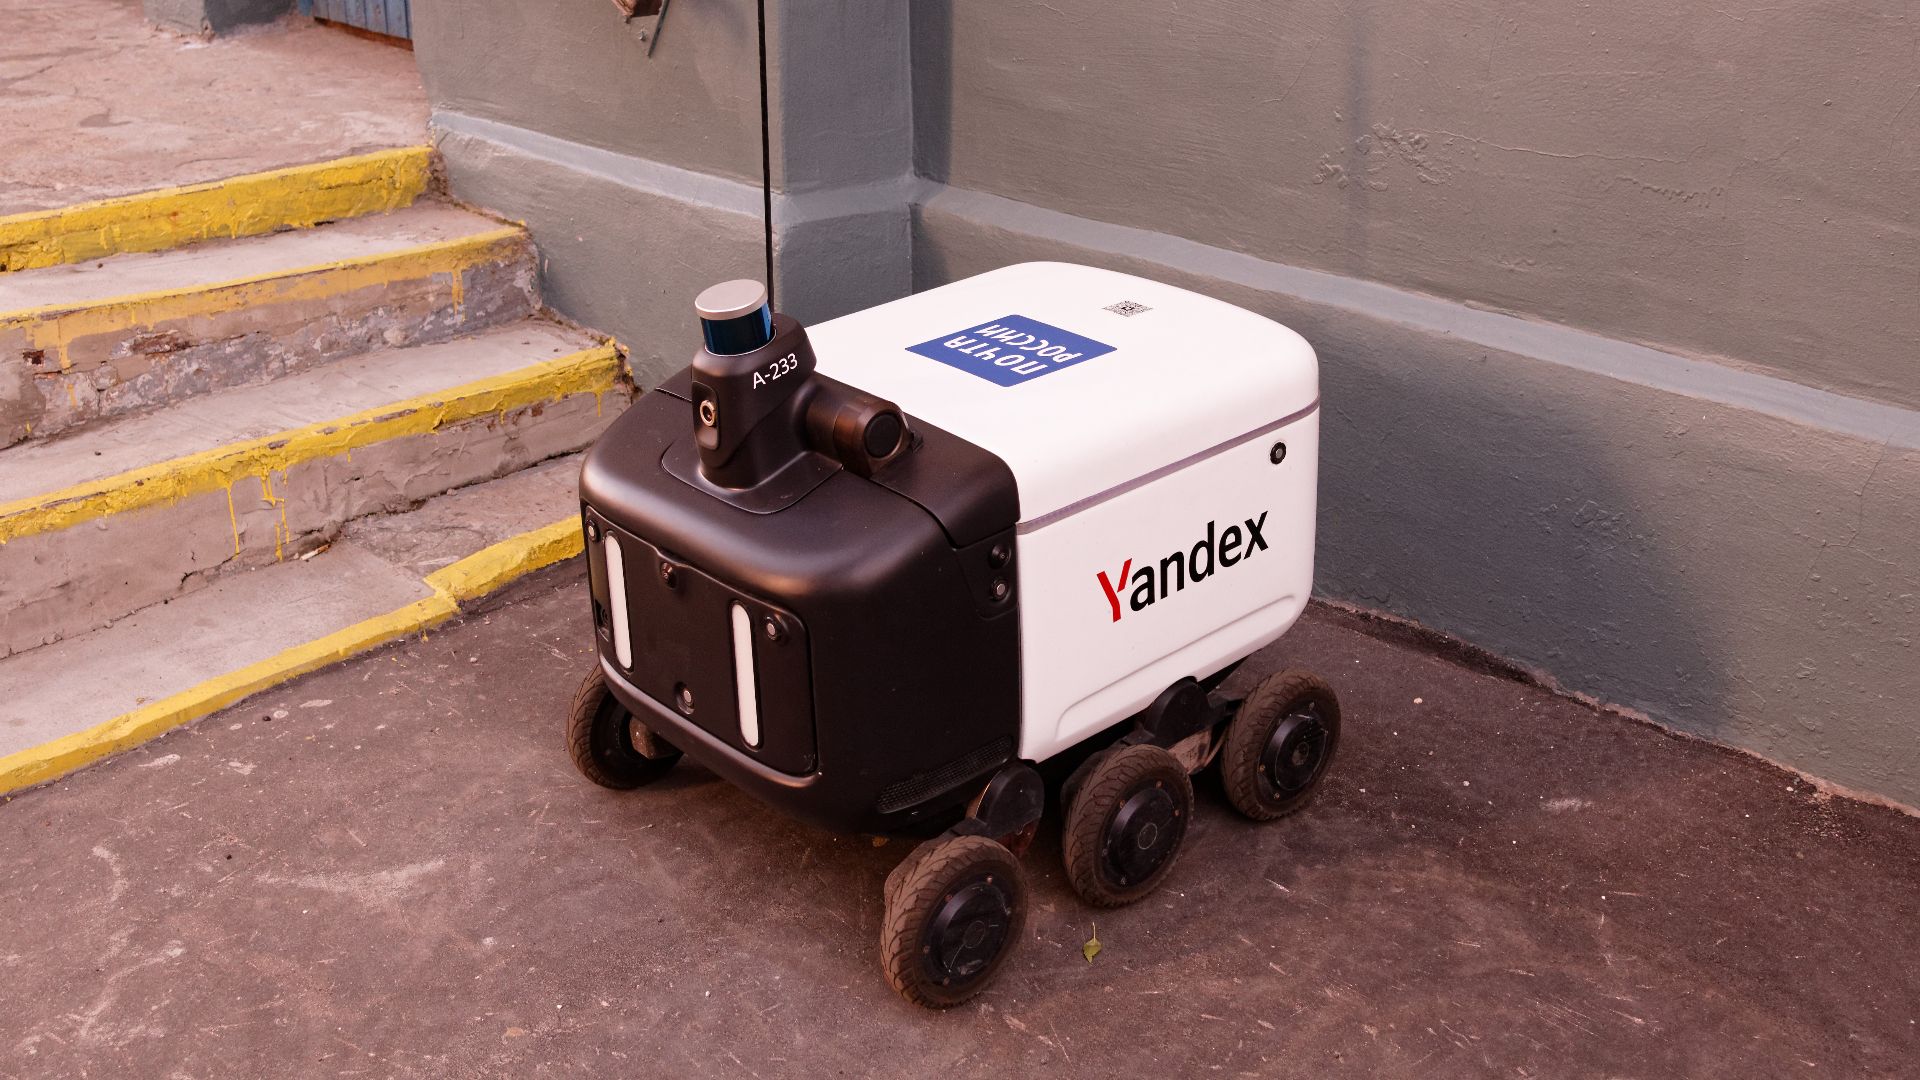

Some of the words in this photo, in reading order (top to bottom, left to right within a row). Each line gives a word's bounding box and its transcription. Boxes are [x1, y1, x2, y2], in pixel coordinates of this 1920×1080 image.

[943, 335, 1049, 376] ПОЧТА
[973, 324, 1084, 363] РОССИИ
[753, 352, 799, 390] A-233
[1096, 510, 1269, 623] Yandex
